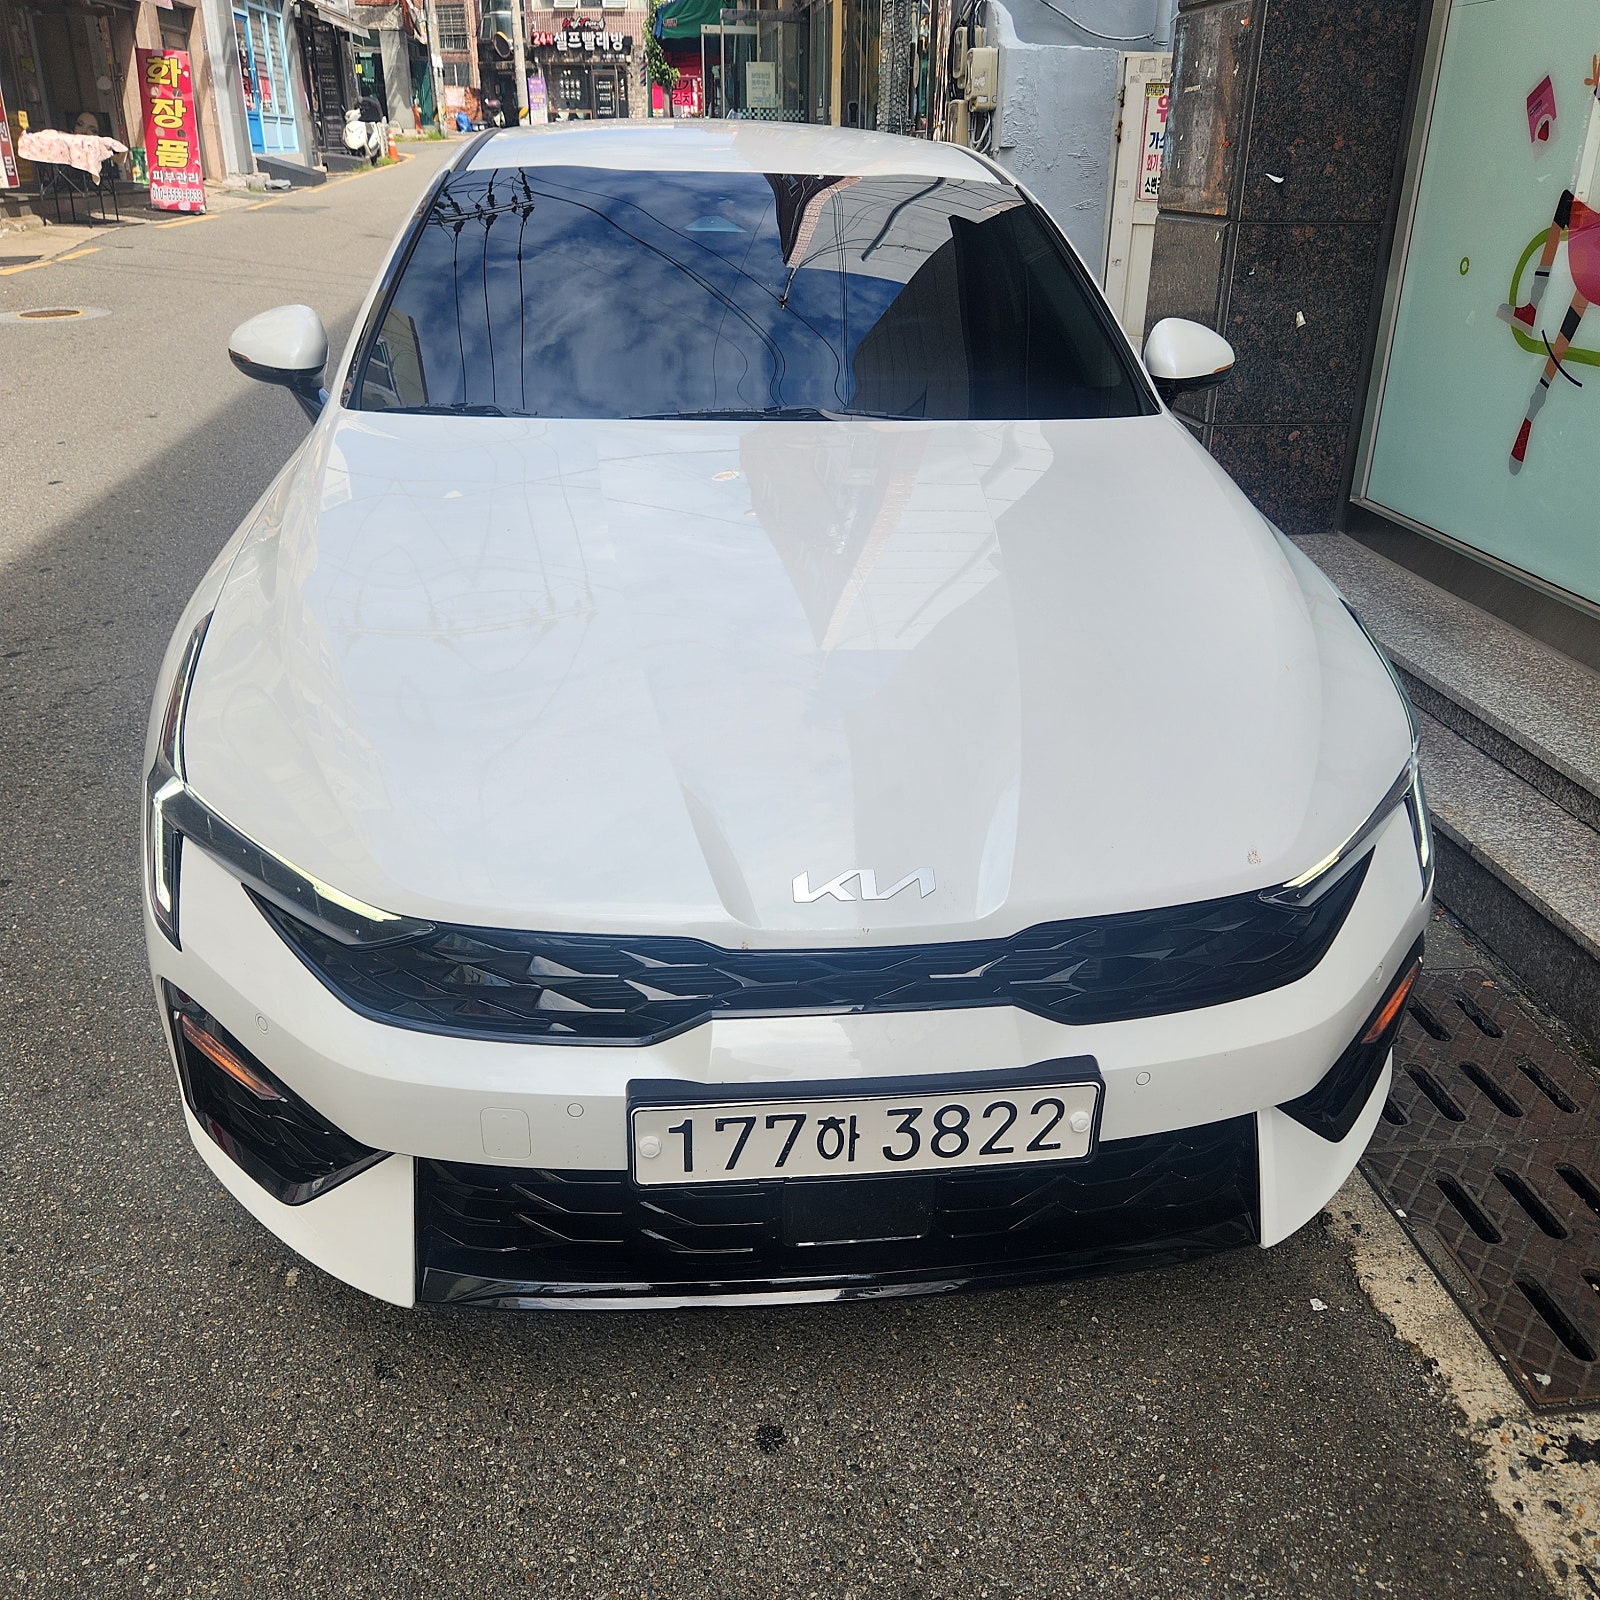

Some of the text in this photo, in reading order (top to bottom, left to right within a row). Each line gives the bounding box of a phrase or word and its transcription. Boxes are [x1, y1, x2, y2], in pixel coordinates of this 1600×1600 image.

[533, 31, 624, 51] 24시 셀프빨래방
[145, 56, 189, 168] 화장품
[152, 170, 199, 185] 피부관리
[668, 1097, 1066, 1172] 177하 3822
